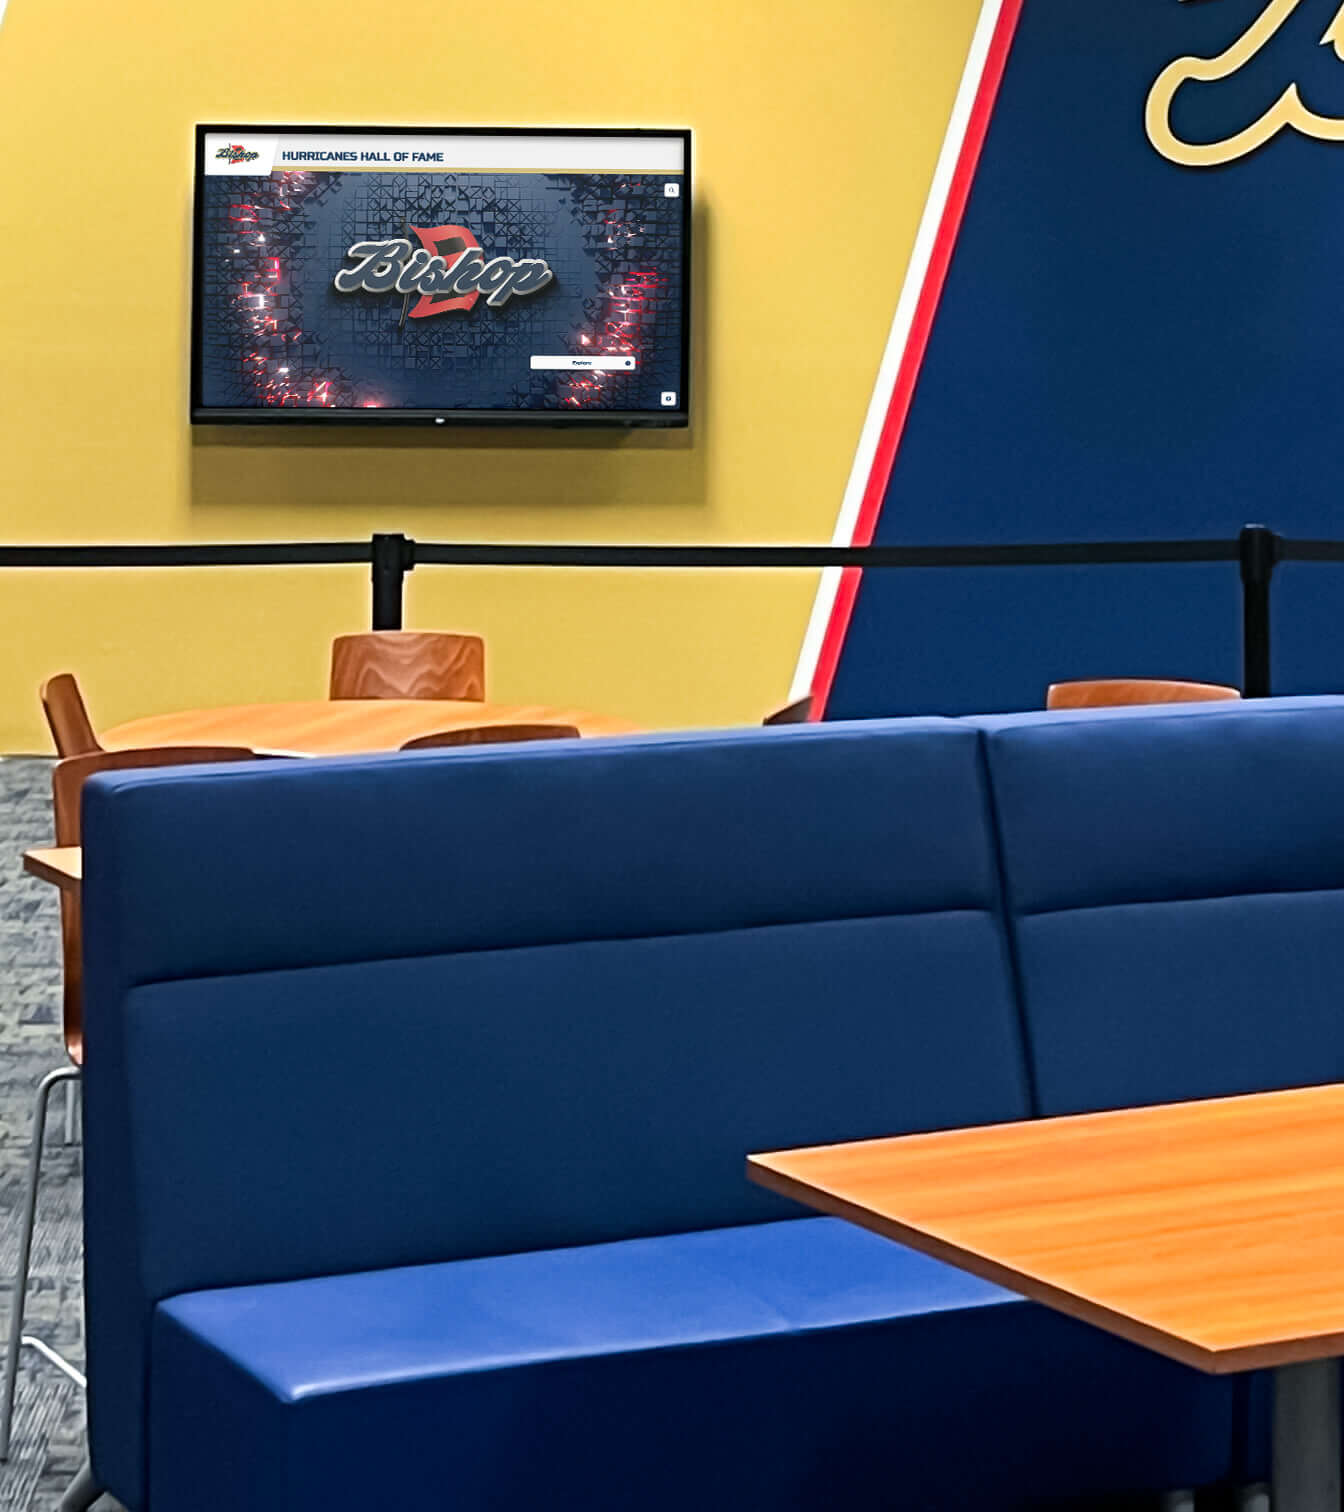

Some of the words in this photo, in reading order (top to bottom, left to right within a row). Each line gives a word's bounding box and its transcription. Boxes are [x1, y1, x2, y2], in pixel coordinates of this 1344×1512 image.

[215, 146, 259, 161] Bishop
[282, 151, 358, 161] HURRICANES
[360, 152, 391, 161] HALL
[394, 152, 409, 162] OF
[411, 152, 444, 162] FAME
[335, 239, 553, 307] Bishop
